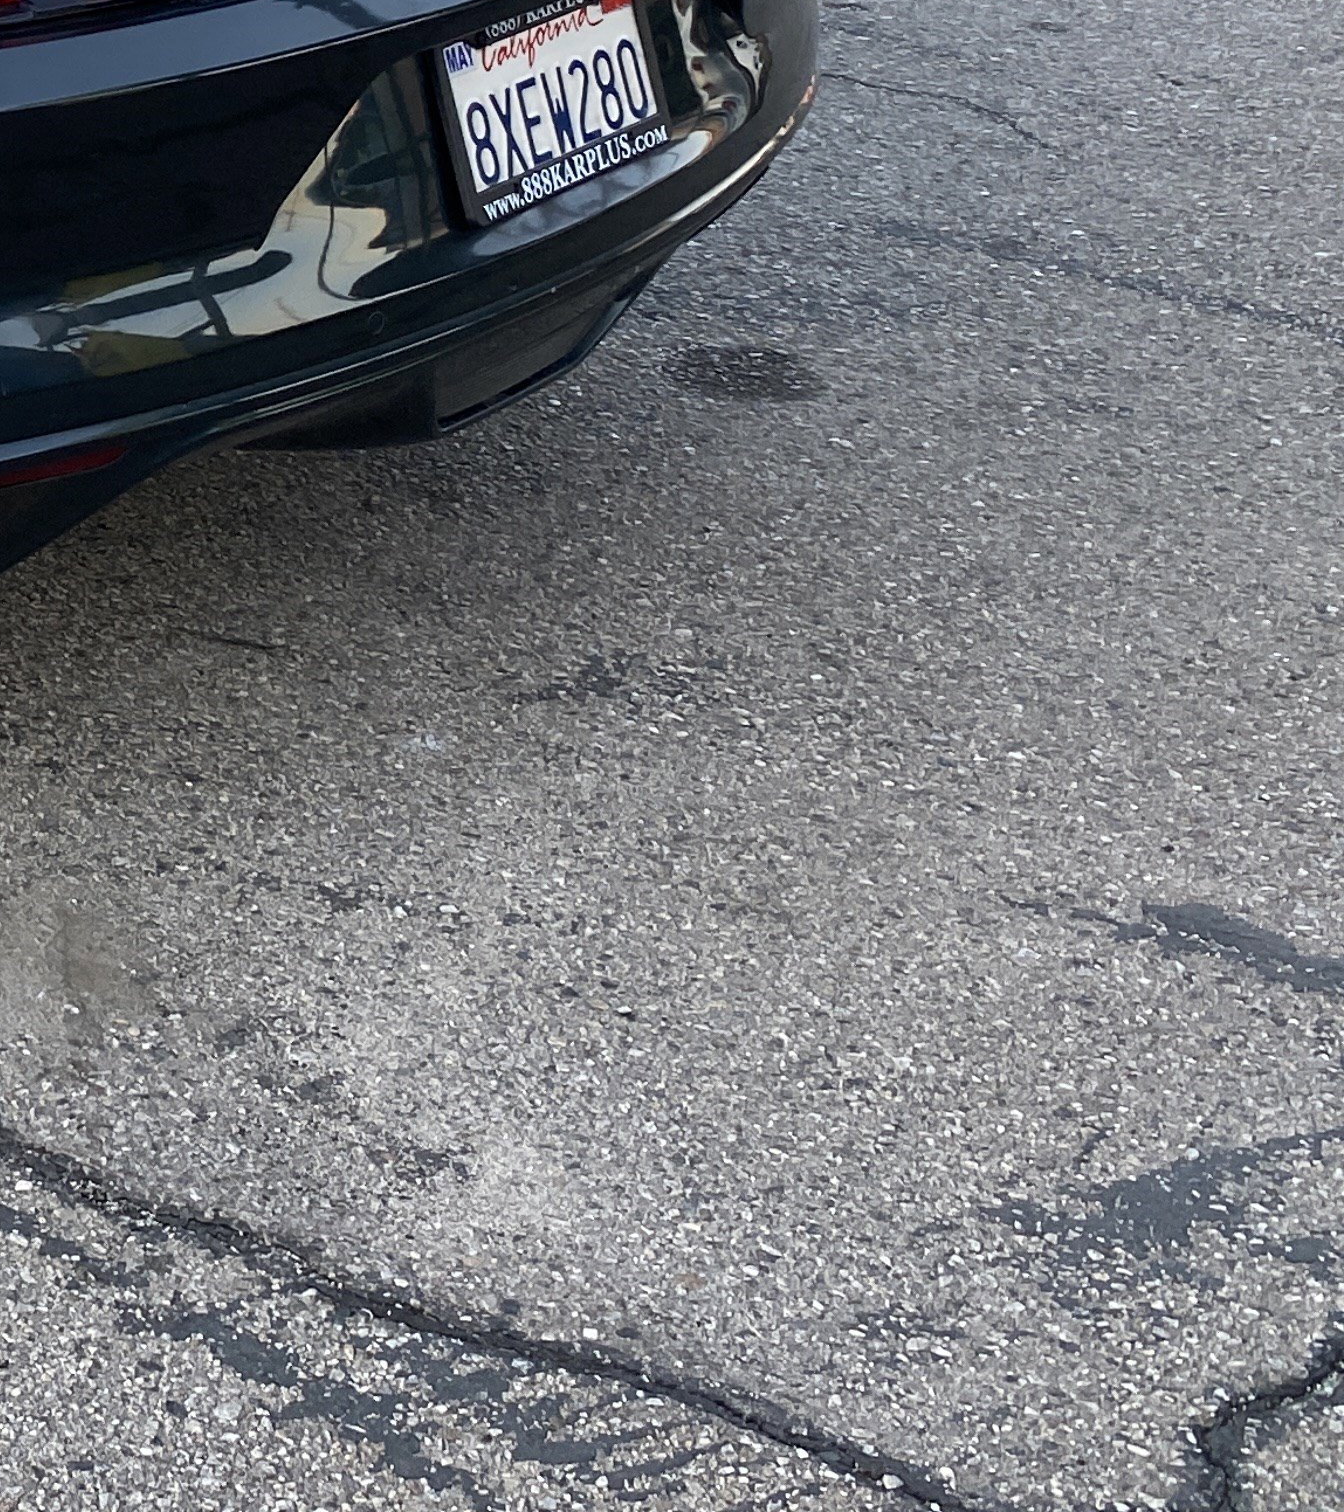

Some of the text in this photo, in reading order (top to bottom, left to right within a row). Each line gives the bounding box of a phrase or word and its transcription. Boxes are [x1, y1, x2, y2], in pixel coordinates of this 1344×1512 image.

[445, 44, 474, 73] MAY
[481, 7, 604, 72] California
[466, 38, 649, 186] 8XEW280
